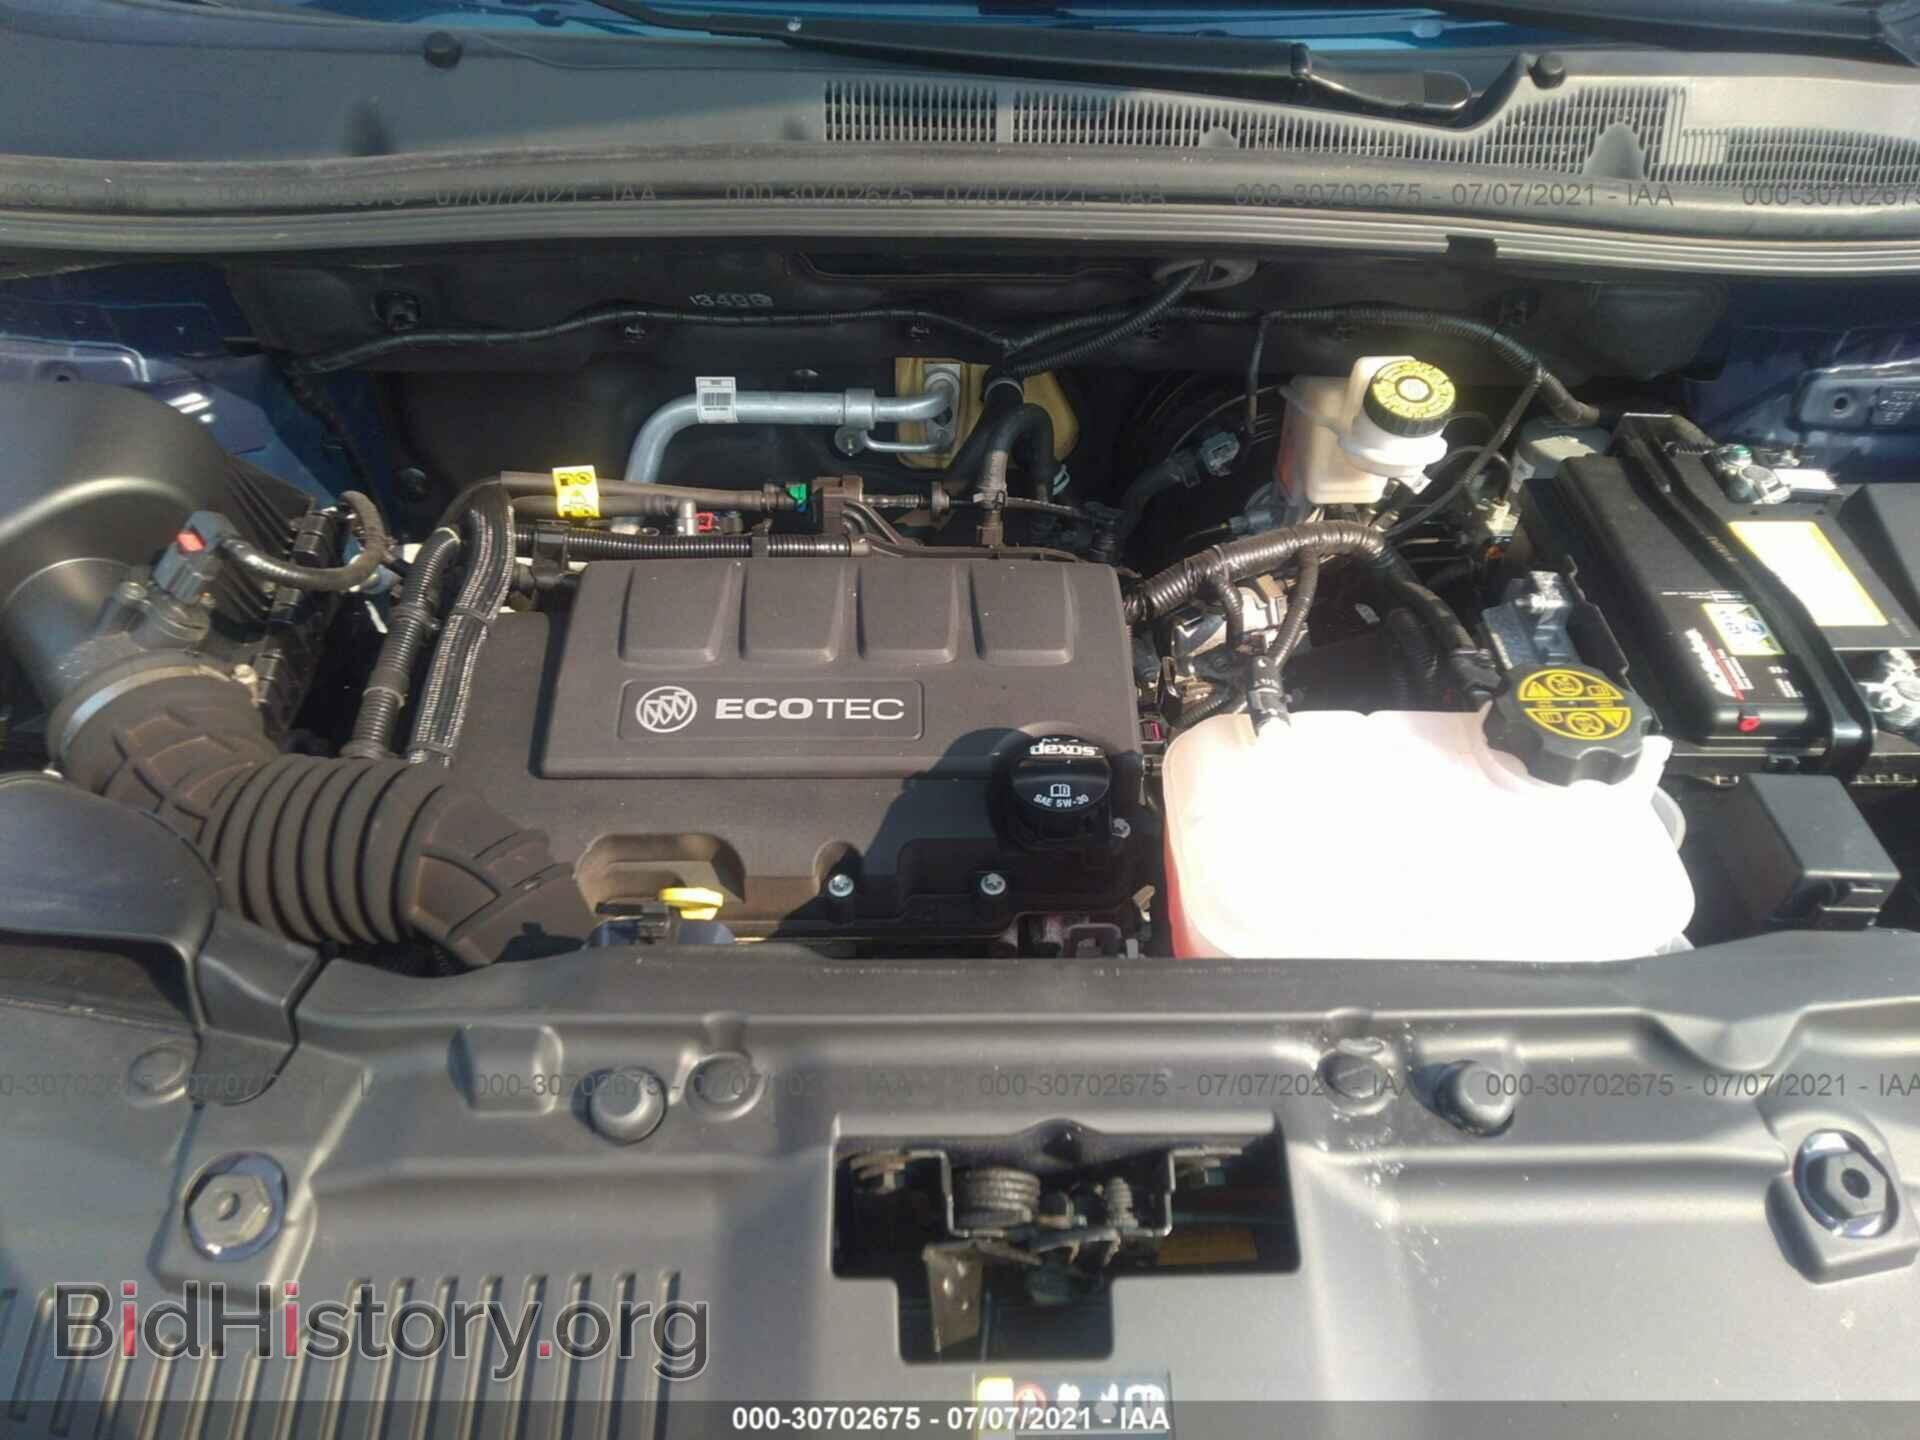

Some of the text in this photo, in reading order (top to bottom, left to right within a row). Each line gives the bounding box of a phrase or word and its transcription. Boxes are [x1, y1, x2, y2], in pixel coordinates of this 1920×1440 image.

[715, 698, 904, 720] ECOTEC
[1029, 742, 1098, 756] dexos
[1033, 794, 1052, 807] SAE
